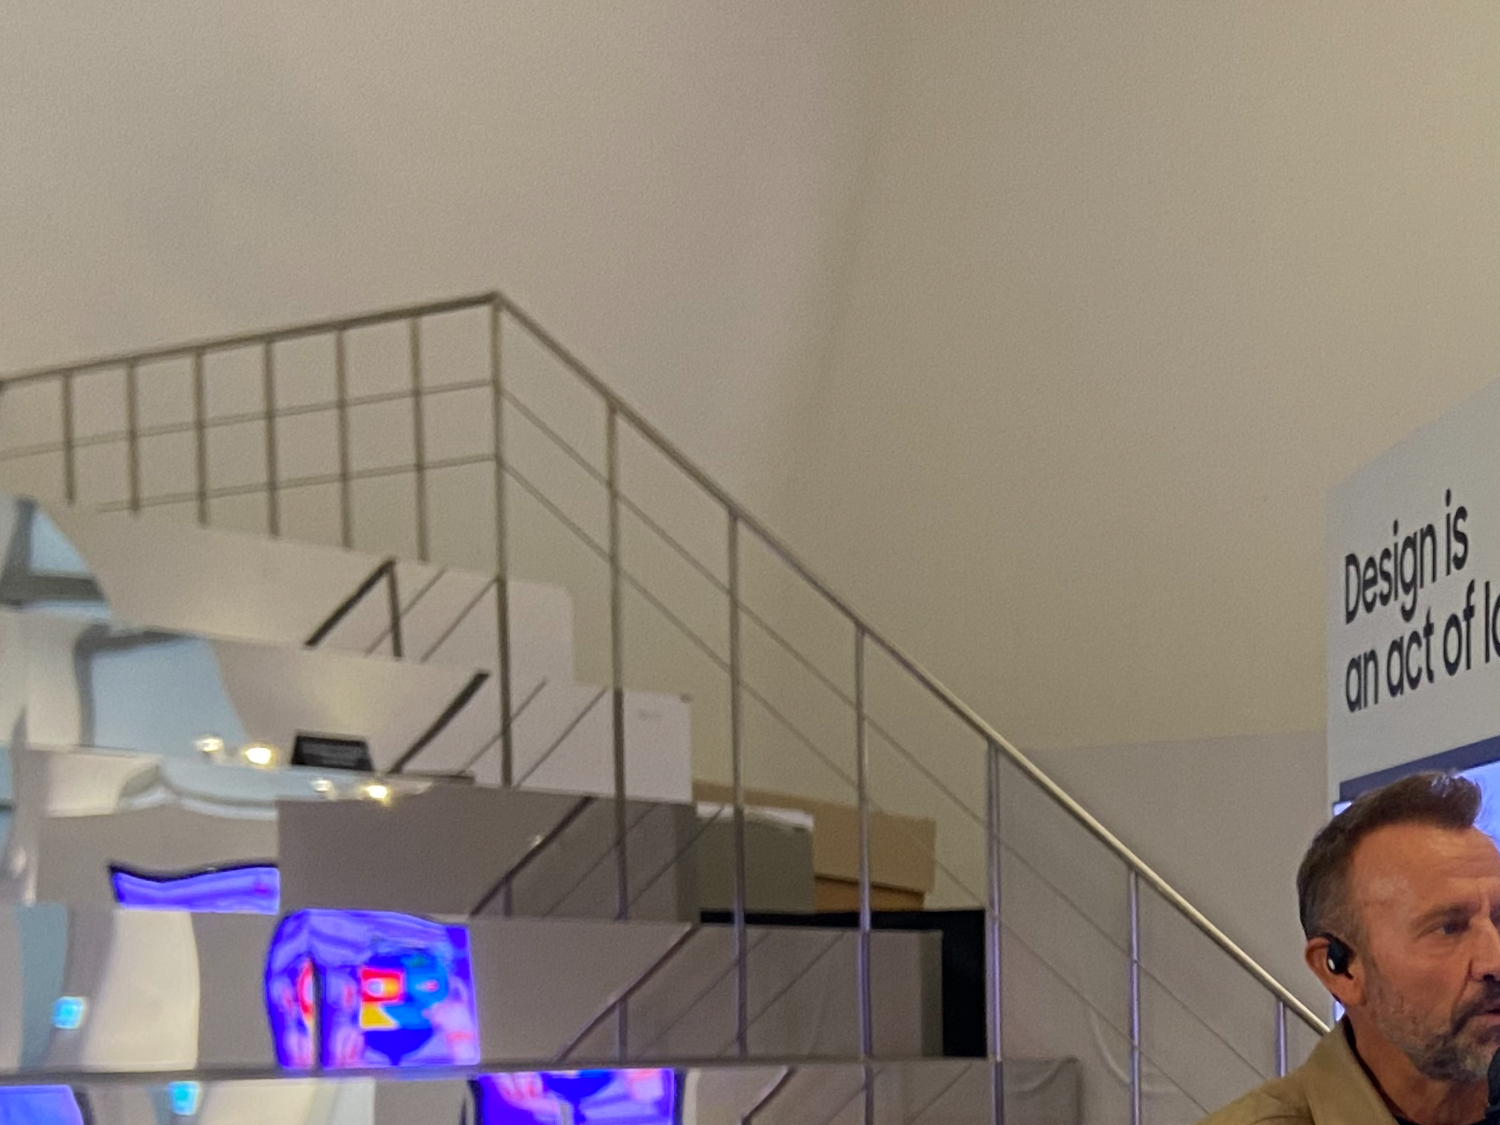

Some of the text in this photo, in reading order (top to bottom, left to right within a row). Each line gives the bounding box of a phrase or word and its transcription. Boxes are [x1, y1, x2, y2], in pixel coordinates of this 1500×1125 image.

[1345, 488, 1470, 624] Design is
[1345, 647, 1379, 712] an
[1386, 607, 1435, 698] act
[1443, 580, 1475, 676] of
